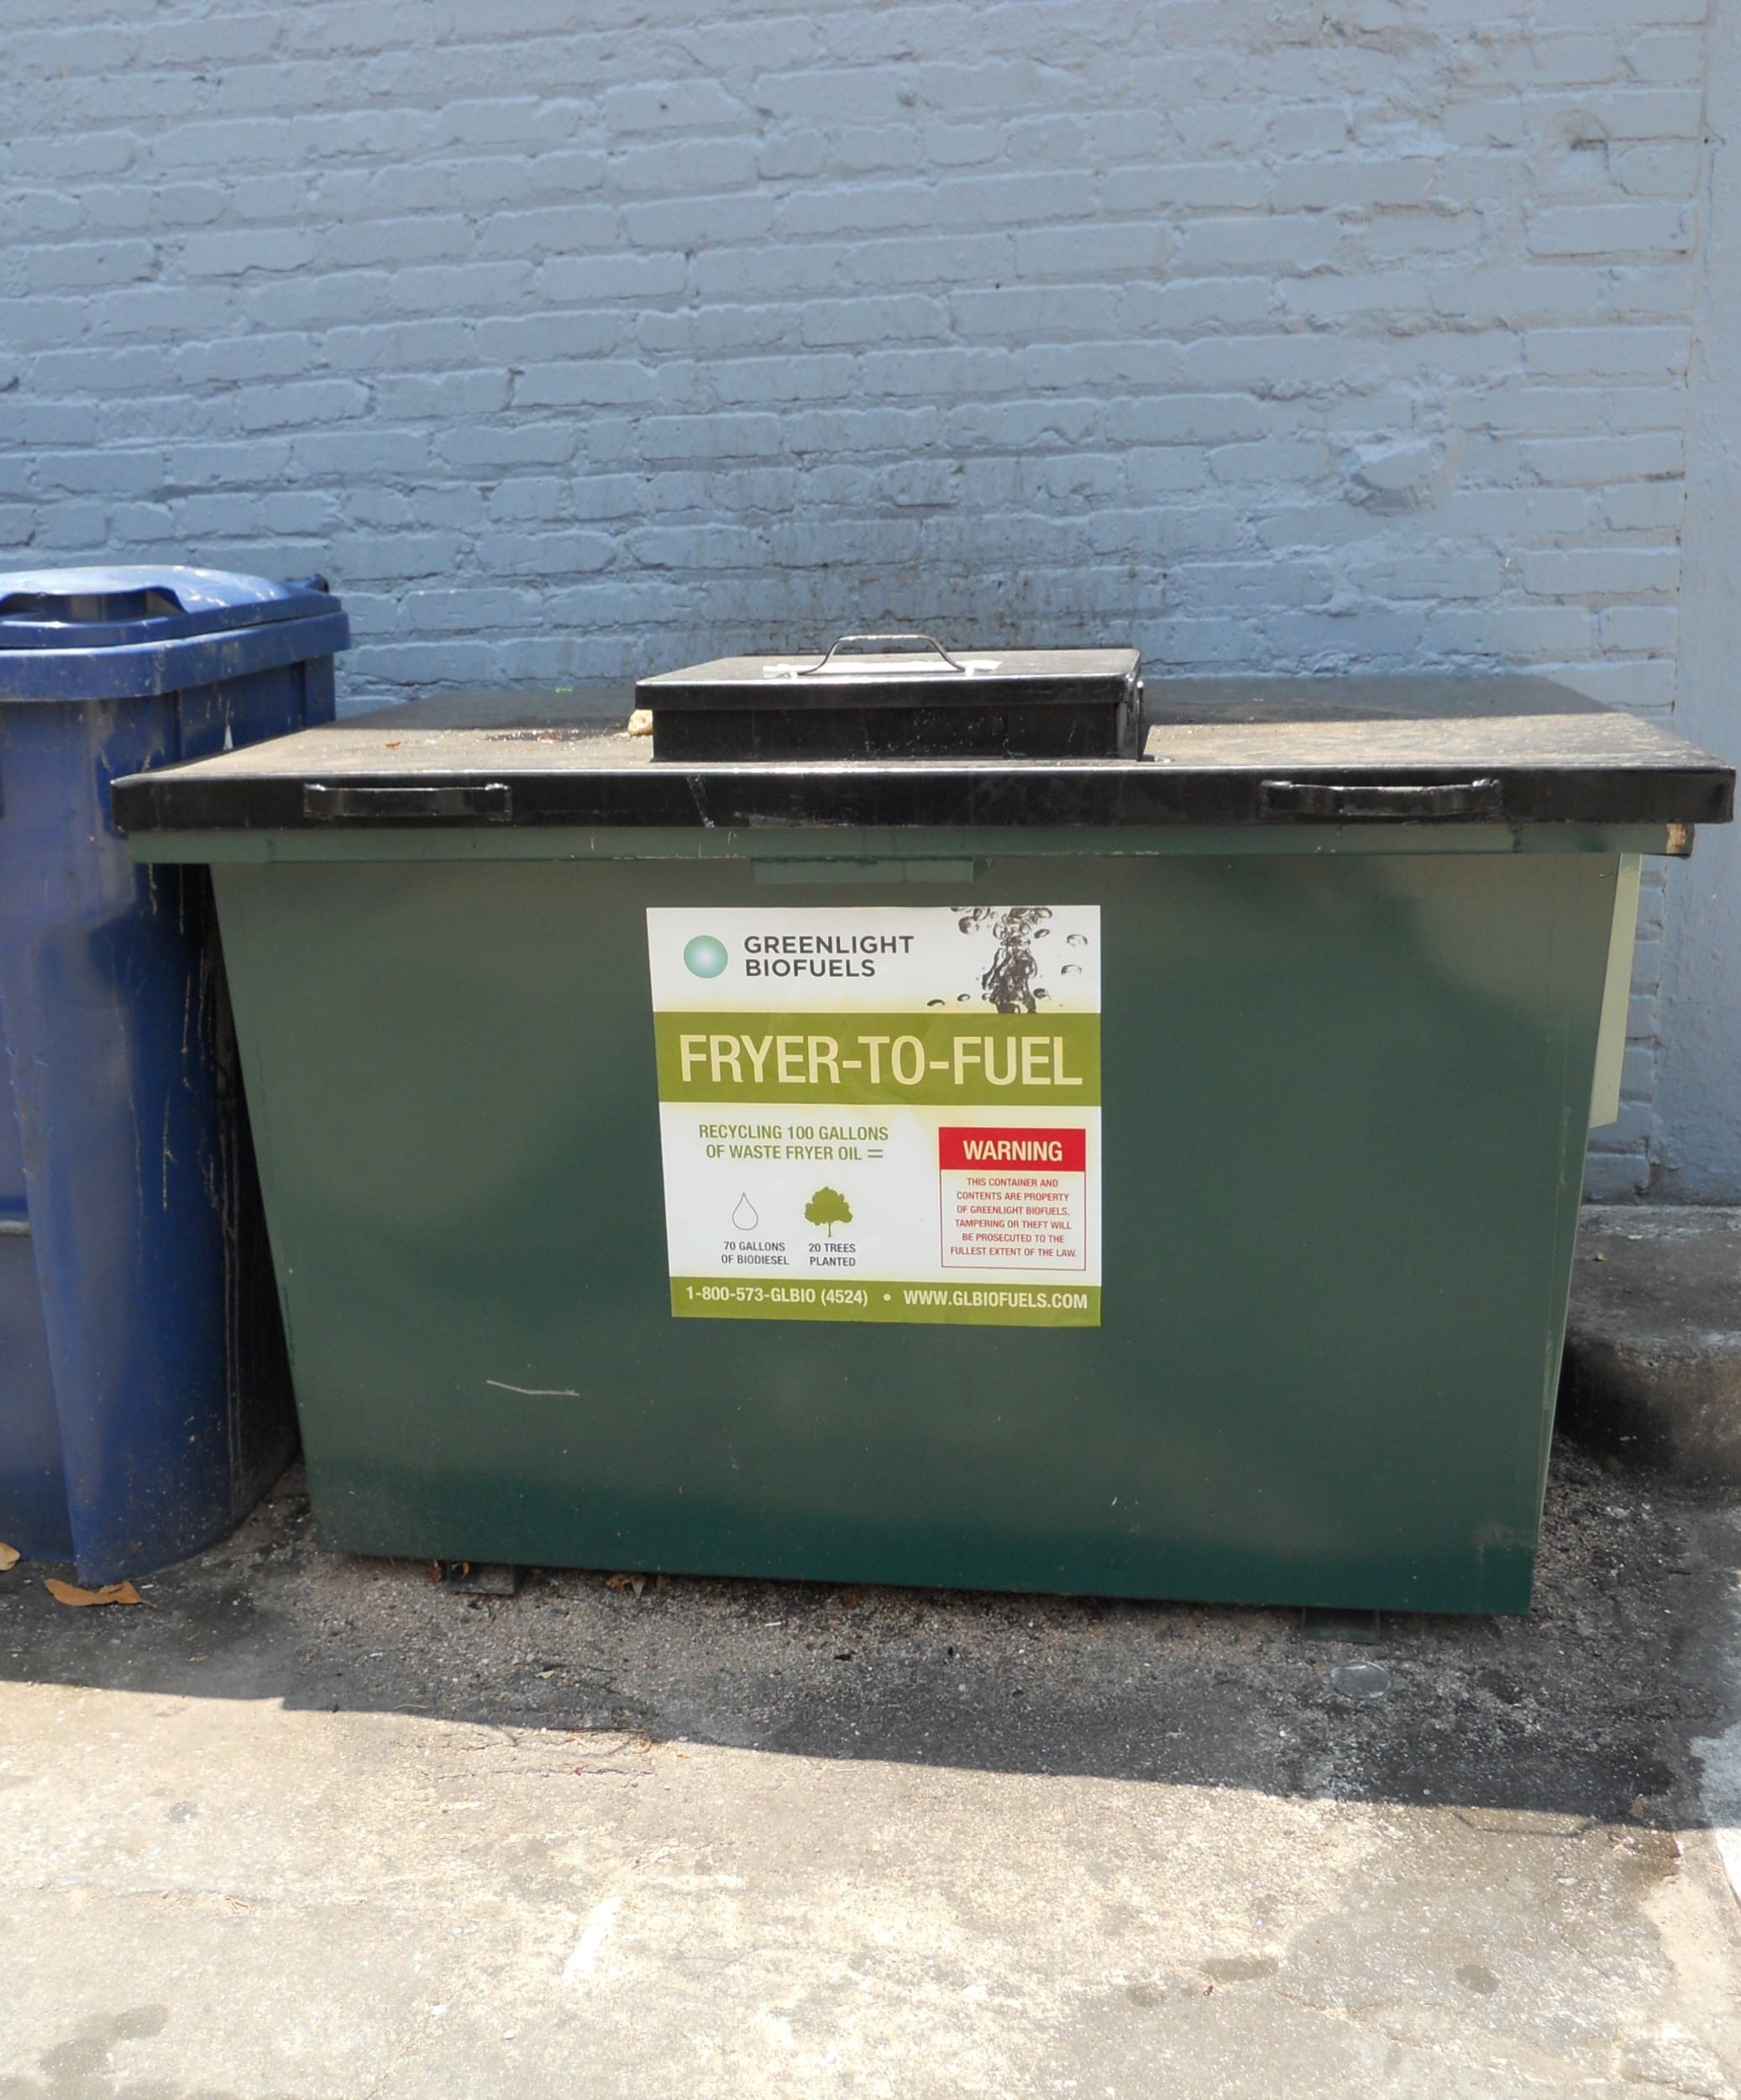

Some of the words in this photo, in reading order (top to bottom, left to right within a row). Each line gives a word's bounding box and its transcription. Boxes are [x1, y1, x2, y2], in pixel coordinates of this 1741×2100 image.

[744, 935, 914, 954] GREENLIGHT
[745, 959, 875, 977] BIOFUELS
[679, 1034, 1083, 1086] FRYER-TO-FUEL
[699, 1124, 782, 1139] RECYCLING
[787, 1126, 814, 1139] 100
[819, 1126, 889, 1140] GALLONS
[706, 1144, 725, 1158] OF
[729, 1145, 781, 1159] WASTE
[786, 1146, 833, 1160] FRYER
[838, 1147, 862, 1160] OIL
[963, 1140, 1062, 1161] WARNING
[968, 1178, 986, 1186] THIS
[988, 1178, 1037, 1186] CONTAINER
[1040, 1179, 1058, 1187] AND
[957, 1191, 1002, 1200] CONTENTS
[1004, 1192, 1021, 1201] ARE
[1024, 1192, 1069, 1202] PROPERTY
[957, 1206, 968, 1214] OF
[970, 1206, 1023, 1215] GREENLIGHT
[1026, 1207, 1069, 1216] BIOFUELS.
[955, 1219, 1004, 1228] TAMPERING
[1007, 1220, 1020, 1228] OR
[1022, 1220, 1048, 1228] THEFT
[1051, 1221, 1072, 1229] WILL
[976, 1233, 1031, 1243] PROSECUTED
[1035, 1234, 1046, 1243] TO
[724, 1242, 736, 1250] 70
[739, 1242, 785, 1251] GALLONS
[809, 1244, 821, 1252] 20
[824, 1244, 856, 1253] TREES
[951, 1247, 986, 1255] FULLEST
[989, 1248, 1021, 1256] EXTENT
[1024, 1248, 1035, 1256] OF
[1057, 1249, 1078, 1257] LAW.
[721, 1254, 733, 1264] OF
[737, 1255, 789, 1265] BIODIESEL
[810, 1257, 856, 1266] PLANTED
[686, 1286, 815, 1303] 1-800-573-GLBIO
[821, 1289, 868, 1307] (4524)
[904, 1290, 1088, 1309] WWW.GLBIOFUELS.COM
